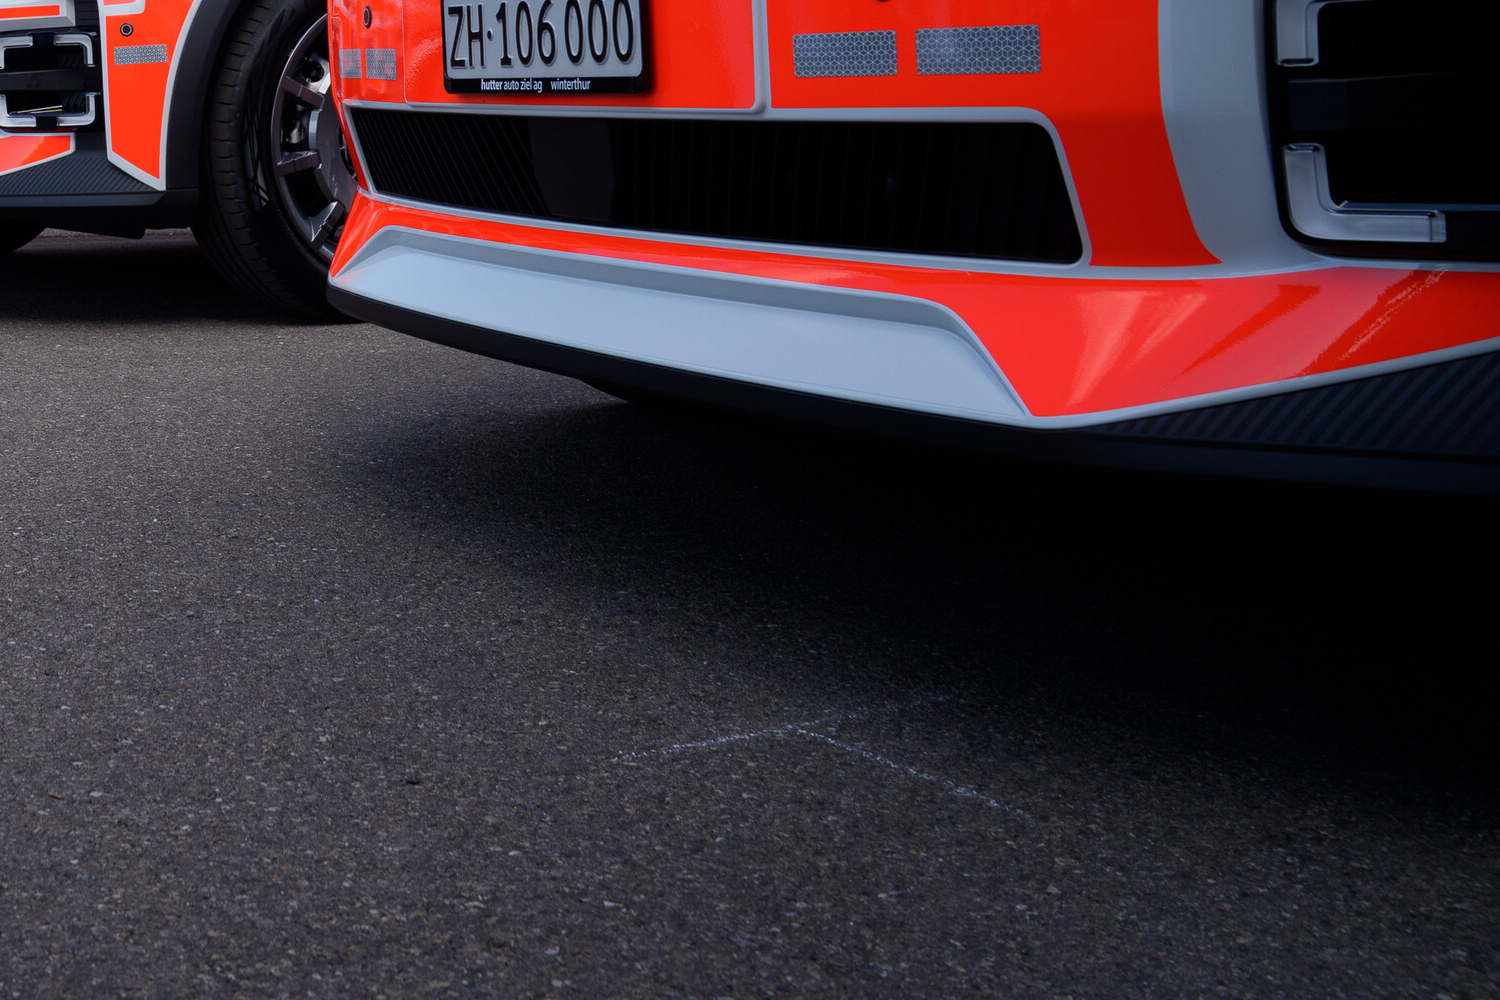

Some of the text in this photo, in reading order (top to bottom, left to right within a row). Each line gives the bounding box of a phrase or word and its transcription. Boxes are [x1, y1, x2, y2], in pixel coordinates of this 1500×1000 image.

[480, 77, 591, 93] hutter auto ziel ag winterthur
